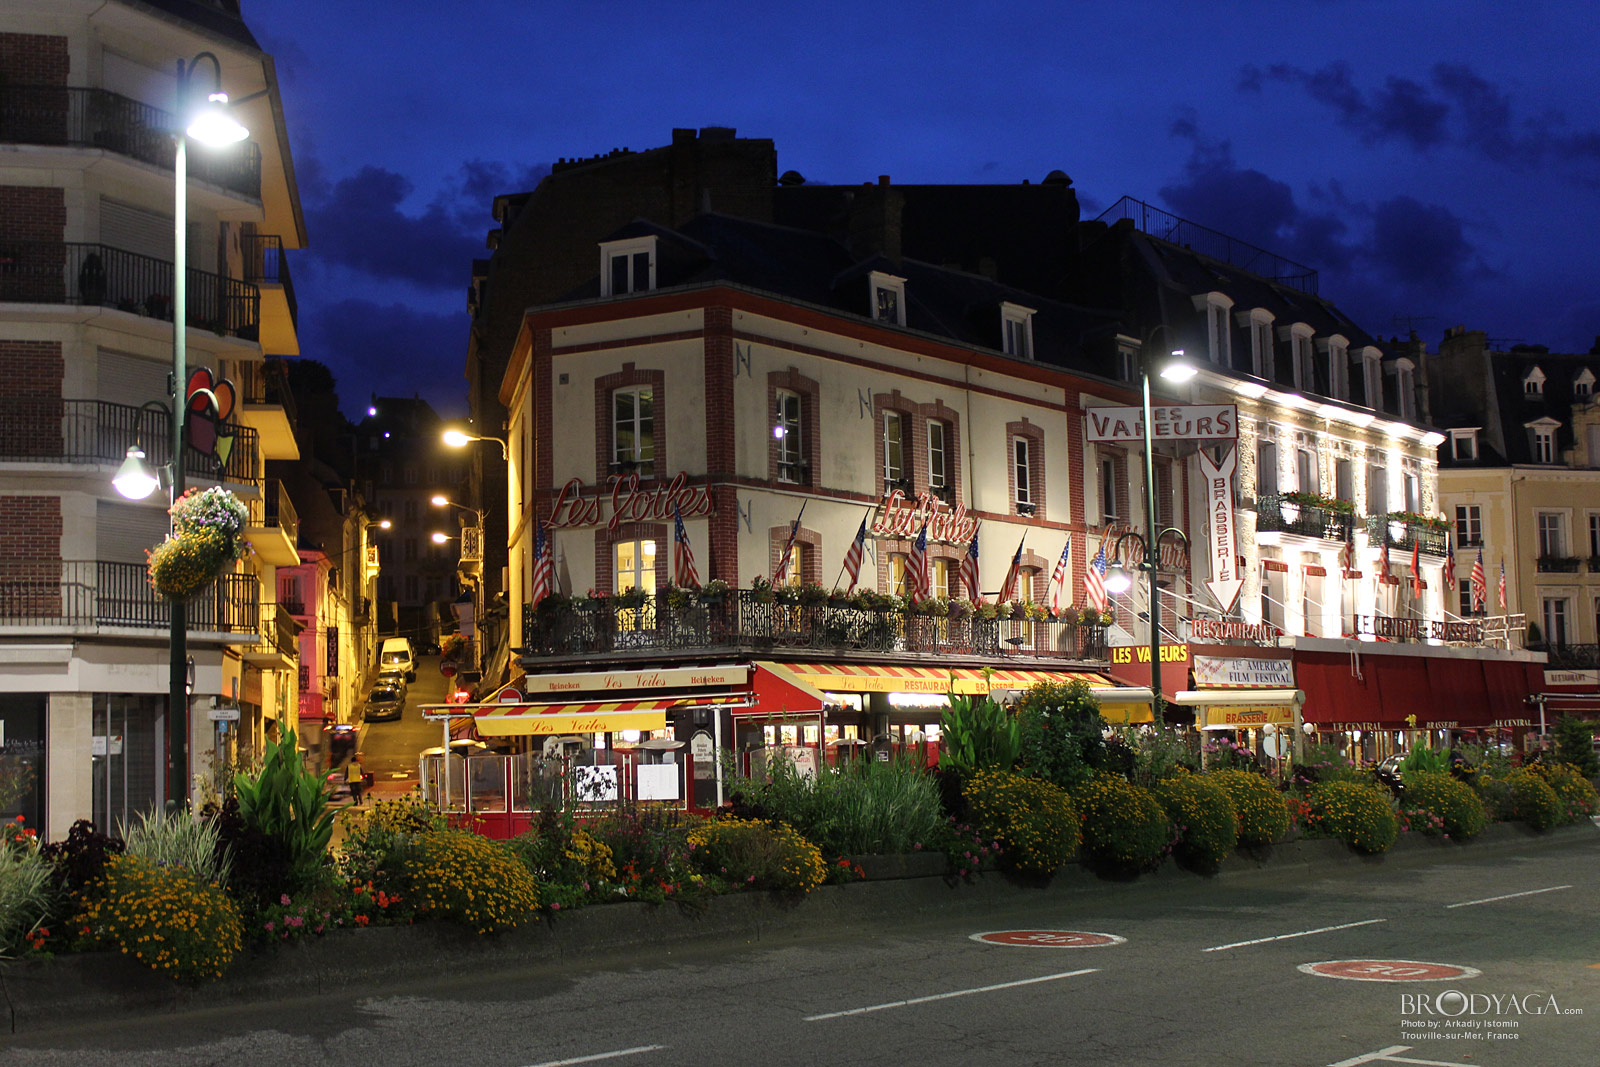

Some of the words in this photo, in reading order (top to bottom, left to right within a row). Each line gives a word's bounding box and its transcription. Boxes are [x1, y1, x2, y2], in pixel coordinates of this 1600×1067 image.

[541, 477, 601, 529] Les
[607, 470, 714, 532] Voiles
[873, 489, 916, 536] Les
[918, 491, 981, 542] Voiles
[1213, 477, 1230, 582] BRASSERIE
[1191, 619, 1275, 641] RESTAURANT
[1113, 647, 1132, 664] LES
[1136, 644, 1188, 663] VAEURS
[1248, 660, 1289, 672] AMERICAN
[549, 682, 580, 690] Heineken
[603, 675, 623, 688] Les
[636, 673, 666, 687] Voiles
[691, 676, 725, 684] Heineken
[1229, 671, 1250, 682] FILM
[1255, 672, 1292, 683] FESTIVAL
[905, 680, 953, 692] RESTAURAN
[1225, 713, 1268, 723] BRASSERIE
[1426, 720, 1459, 728] BRASSERIE
[1504, 718, 1531, 727] CENTRAL
[530, 719, 554, 732] Les
[571, 719, 607, 731] Voiles
[1345, 722, 1382, 731] CENTRAL
[1346, 964, 1429, 976] 30
